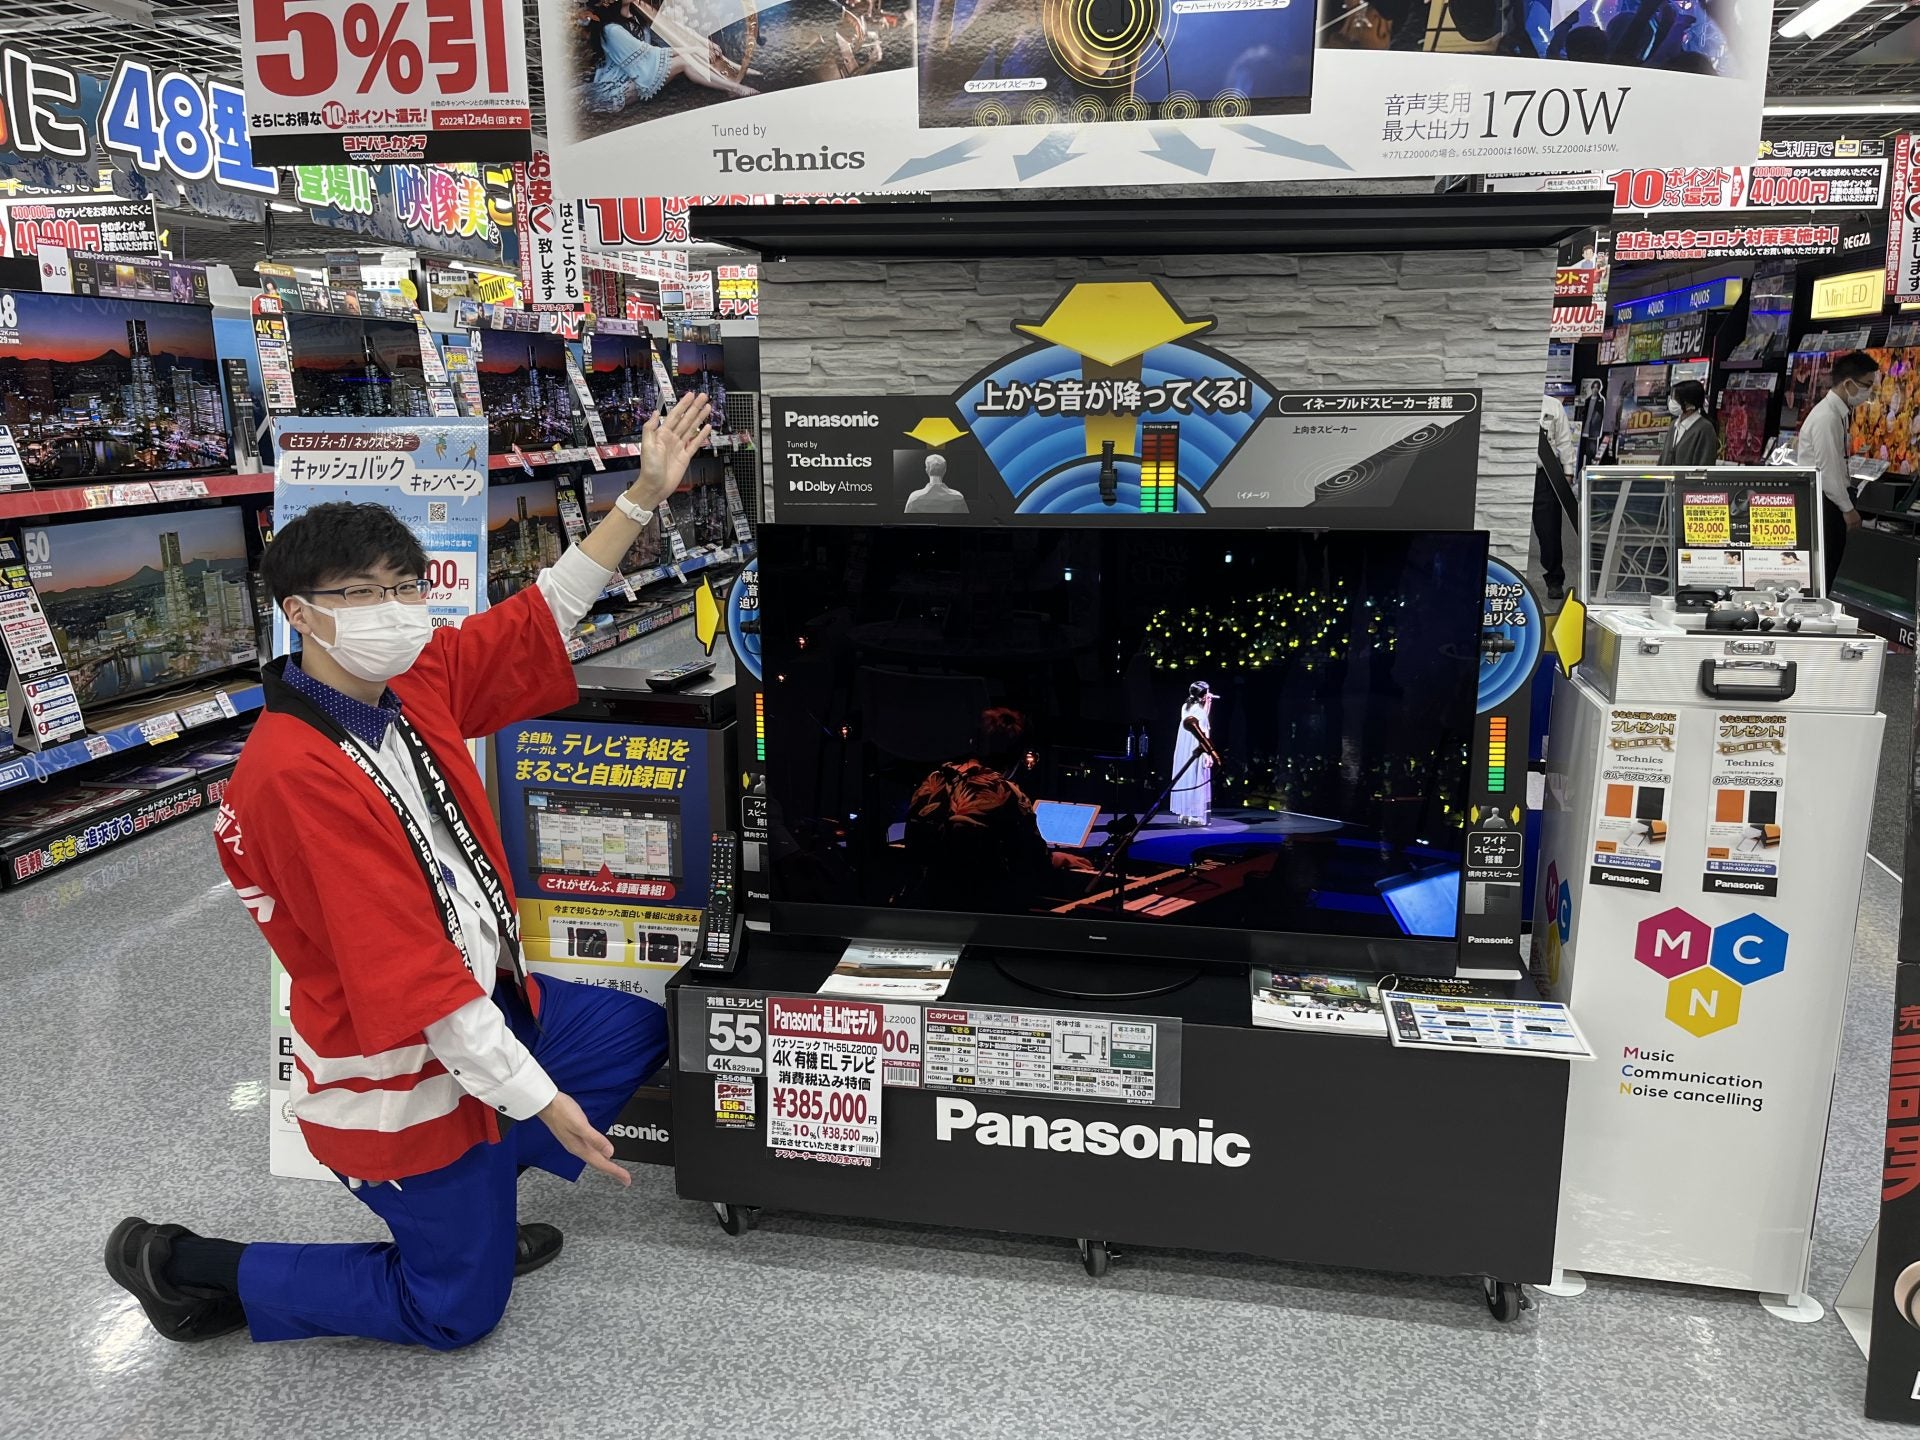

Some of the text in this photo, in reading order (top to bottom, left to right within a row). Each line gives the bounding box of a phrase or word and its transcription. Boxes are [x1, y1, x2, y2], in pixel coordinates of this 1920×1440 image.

[967, 80, 1043, 90] ラインアレイスピーカー
[1384, 92, 1472, 116] 音声実用
[1479, 87, 1632, 139] 170W
[102, 59, 280, 195] 48型
[711, 124, 767, 138] Tuned by
[1382, 119, 1470, 142] 最大出力
[343, 135, 427, 150] ヨドバシカメラ
[350, 150, 425, 160] www.yodobashi.com
[712, 145, 866, 174] Technics
[1793, 167, 1880, 177] のテレビをお求めいただくと
[1750, 177, 1830, 207] 40,000円
[57, 205, 152, 218] のテレビをお求めいただくと
[1617, 227, 1840, 250] 当店は只今コロナ対策実施中!
[1843, 232, 1871, 250] REGZA
[559, 202, 579, 299] はどこよりも
[55, 267, 67, 277] LG
[1690, 289, 1710, 307] AQUOS
[1825, 283, 1868, 306] Mini LED
[1617, 306, 1633, 320] AQUOS
[1647, 299, 1665, 315] AQUOS
[256, 319, 271, 335] 4K
[976, 378, 1247, 411] 上から音が降ってくる!
[1302, 397, 1454, 410] イネーブルドスピーカー搭載
[784, 411, 880, 428] Panasonic
[1292, 425, 1357, 435] 上向きスピーカー
[787, 440, 818, 450] Tuned by
[290, 455, 405, 481] キャッシュバック
[787, 453, 872, 468] Technics
[410, 473, 477, 492] キャンペーン
[805, 480, 873, 494] Dolby Atmos
[1236, 491, 1270, 499] (イメージ)
[1687, 522, 1724, 533] ¥28,000
[1752, 525, 1790, 535] ¥15,000
[25, 531, 50, 564] 50
[747, 584, 758, 596] 音
[1485, 583, 1524, 597] 横から
[1490, 597, 1517, 611] 音が
[1611, 720, 1675, 735] プレゼント!
[1719, 725, 1784, 738] プレゼント!
[516, 744, 557, 755] ディーガは
[517, 730, 690, 762] 全自動 テレビ番組を
[1616, 753, 1664, 765] Technics
[1725, 759, 1775, 768] Technics
[515, 758, 687, 790] まるごと自動録画!
[14, 793, 202, 880] 信頼と安さを追求する ヨドバシカメラ
[1482, 836, 1507, 845] ワイド
[1474, 846, 1515, 854] スピーカー
[1485, 855, 1503, 864] 搭載
[1602, 872, 1650, 886] Panasonic
[1715, 879, 1765, 891] Panasonic
[546, 878, 666, 897] これがぜんぶ、録画番組!
[554, 904, 698, 923] 今まで知らなかった面白い番組に出会える
[1467, 935, 1514, 945] Panasonic
[1653, 928, 1692, 960] M
[1732, 935, 1764, 965] C
[706, 996, 724, 1008] 有機
[738, 998, 763, 1009] テレビ
[1688, 987, 1719, 1018] N
[773, 1003, 878, 1036] Panasonic 最上位モデル
[884, 1016, 916, 1024] LZ2000
[929, 1011, 966, 1021] このテレビは
[950, 1026, 970, 1034] できる
[1055, 1020, 1081, 1028] 本体寸法
[708, 1012, 762, 1053] 55
[957, 1035, 972, 1043] できる
[772, 1037, 878, 1055] パナソニック TH-55LZ2000
[772, 1049, 877, 1074] 4K 有機 EL テレビ
[1623, 1046, 1675, 1063] Music
[712, 1057, 732, 1071] 4K
[778, 1071, 871, 1090] 消費税込み特価
[1621, 1064, 1763, 1090] Communication
[1619, 1082, 1763, 1112] Noise cancelling
[772, 1086, 878, 1125] ¥385,000 円
[936, 1097, 1252, 1168] Panasonic
[771, 1137, 855, 1152] 還元させていただきます
